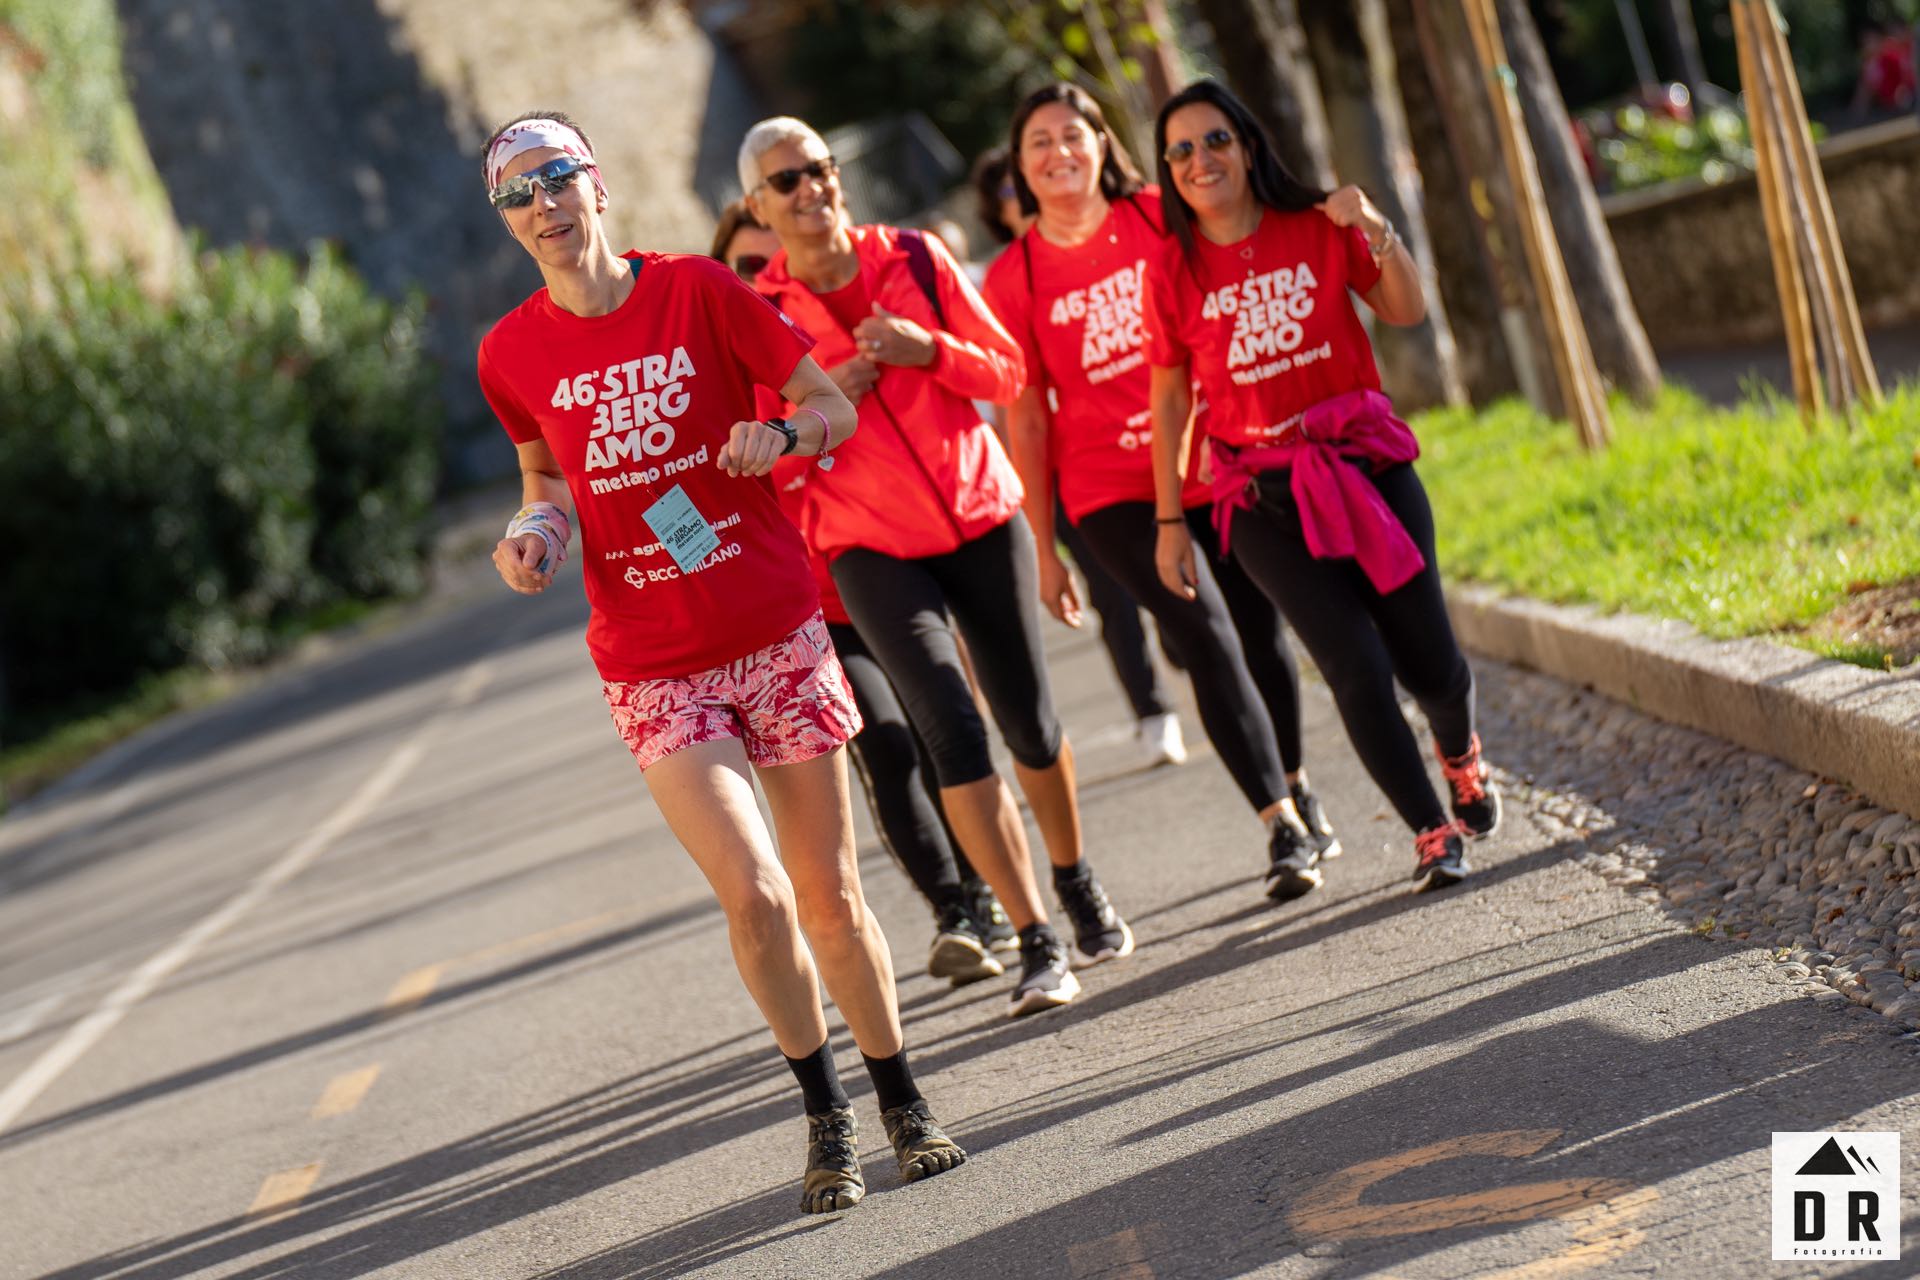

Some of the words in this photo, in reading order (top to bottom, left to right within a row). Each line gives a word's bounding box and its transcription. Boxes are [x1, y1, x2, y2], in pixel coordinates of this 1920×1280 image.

[1240, 261, 1318, 308] STRA
[1227, 320, 1304, 370] AMO
[599, 346, 697, 401] STRA
[585, 422, 676, 472] AMO
[589, 467, 660, 495] metano
[664, 444, 709, 477] nord
[646, 566, 680, 582] BCC
